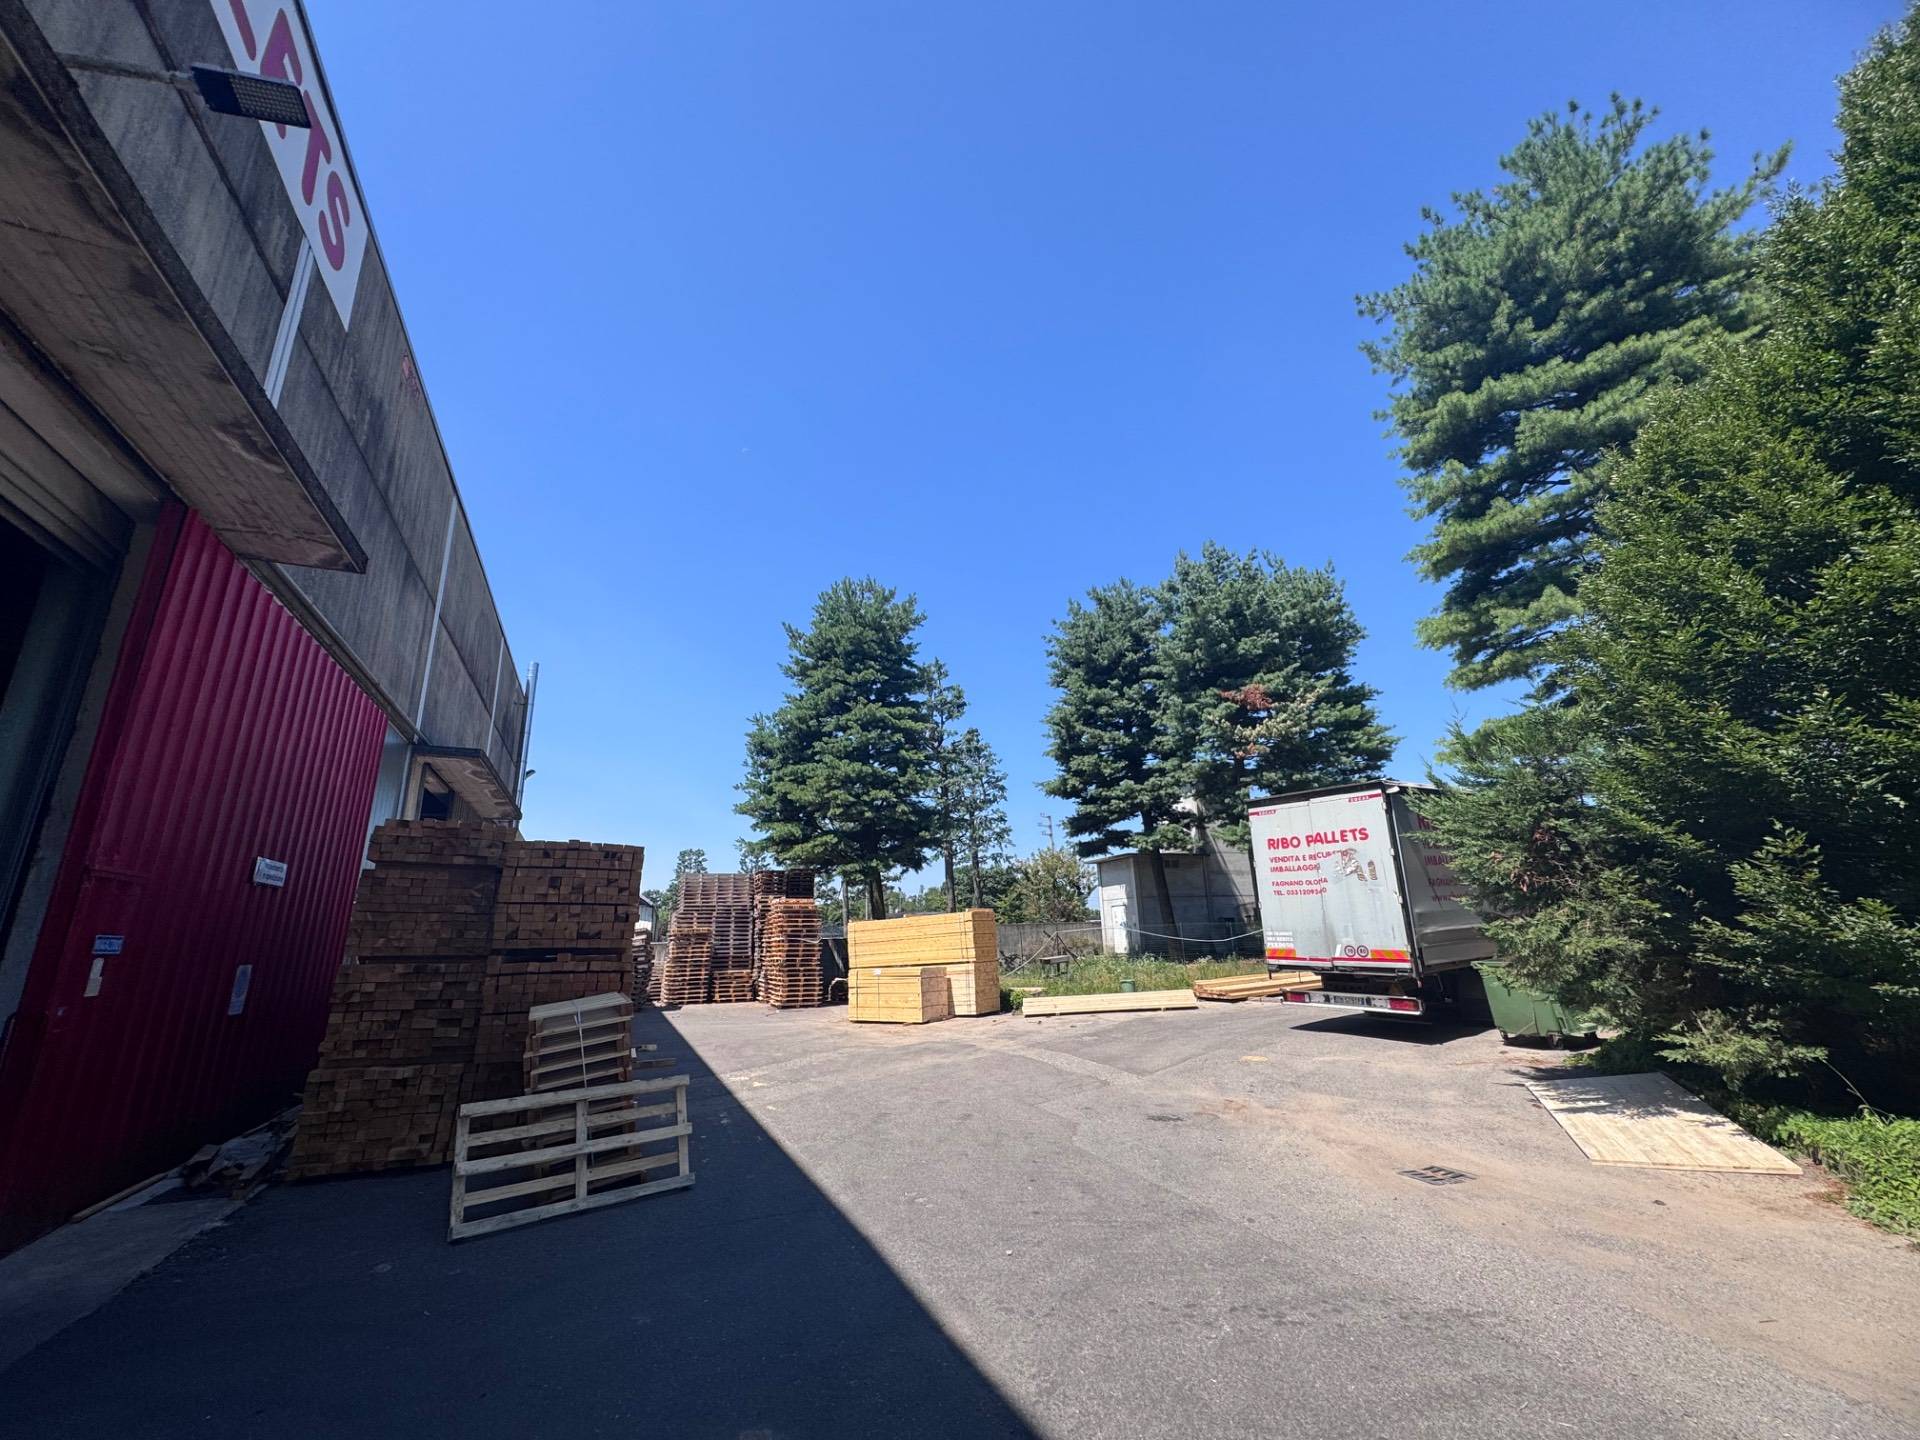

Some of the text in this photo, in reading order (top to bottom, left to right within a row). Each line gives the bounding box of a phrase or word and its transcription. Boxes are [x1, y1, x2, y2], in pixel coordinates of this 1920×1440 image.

[1267, 827, 1369, 850] RIBO PALLETS
[1269, 855, 1300, 863] VENDITA
[1272, 877, 1328, 887] FAGNANO OLONA
